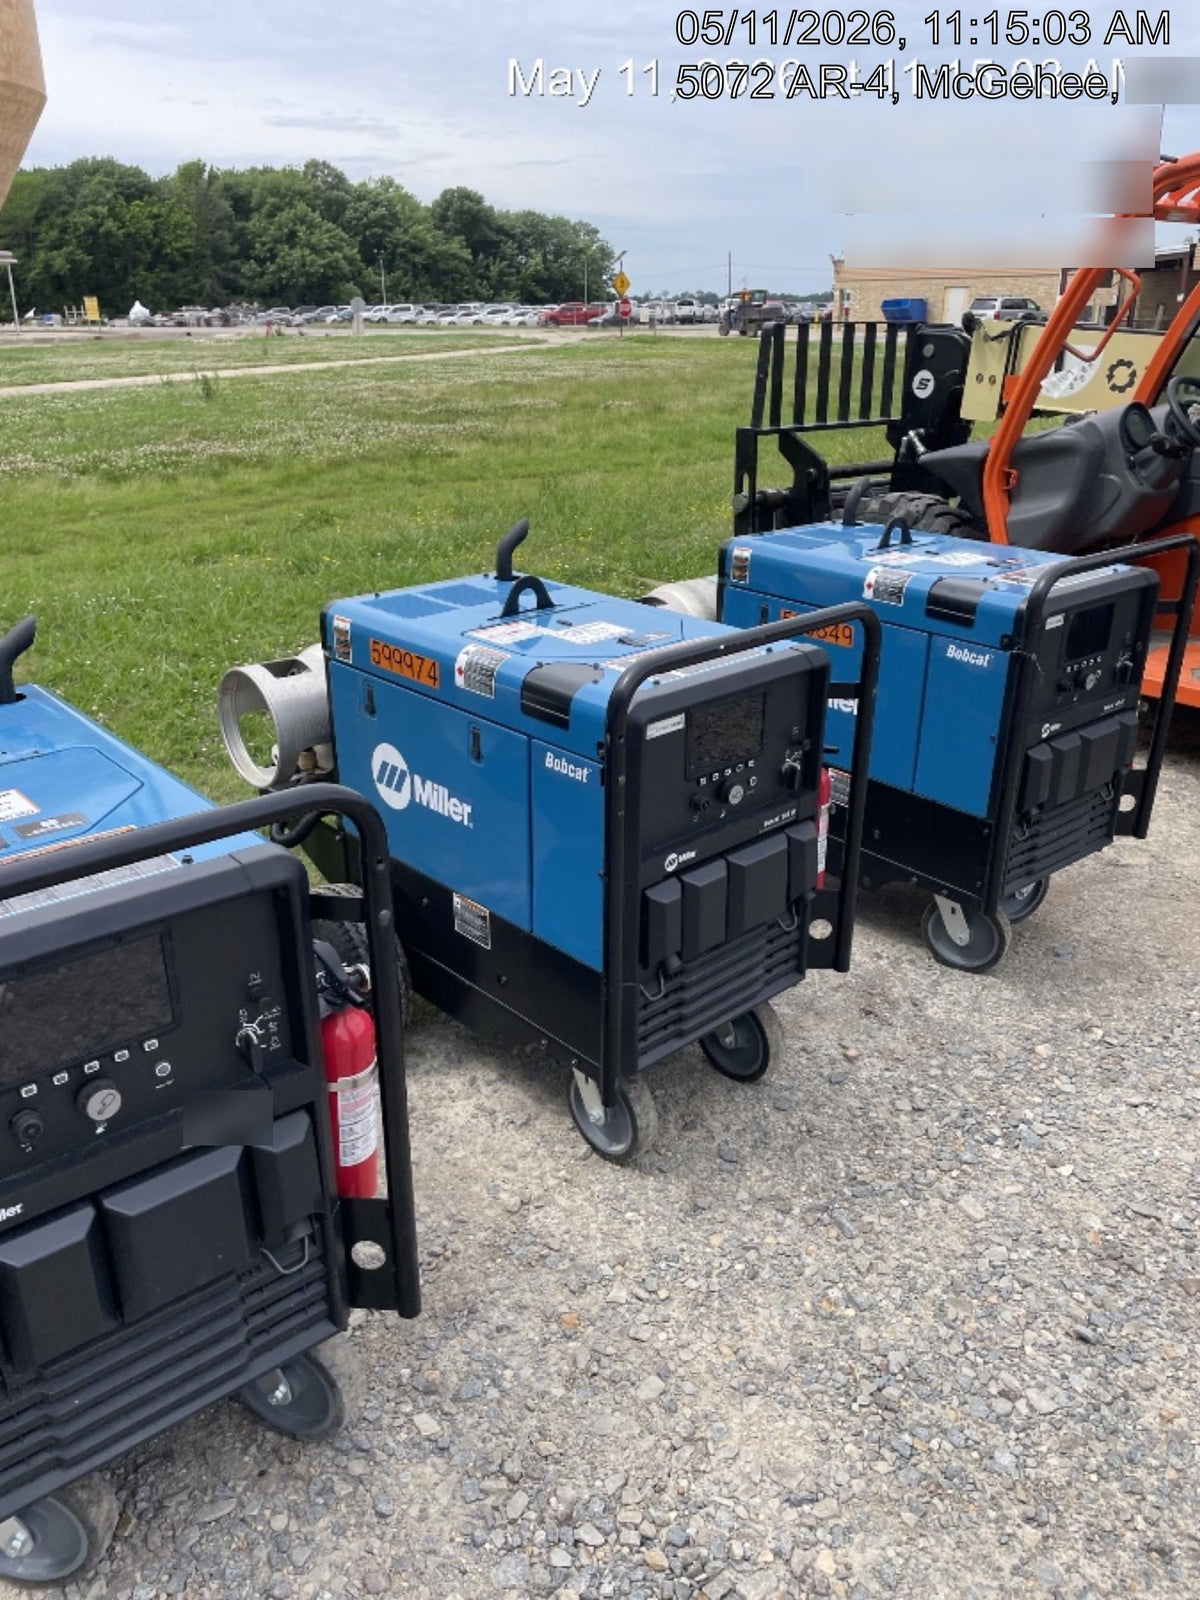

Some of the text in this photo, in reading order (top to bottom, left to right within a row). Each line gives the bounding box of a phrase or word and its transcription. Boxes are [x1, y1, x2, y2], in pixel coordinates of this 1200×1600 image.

[372, 639, 438, 687] 599974
[946, 644, 990, 668] Bobcat
[545, 751, 590, 783] Bobcat
[413, 774, 473, 826] Miller
